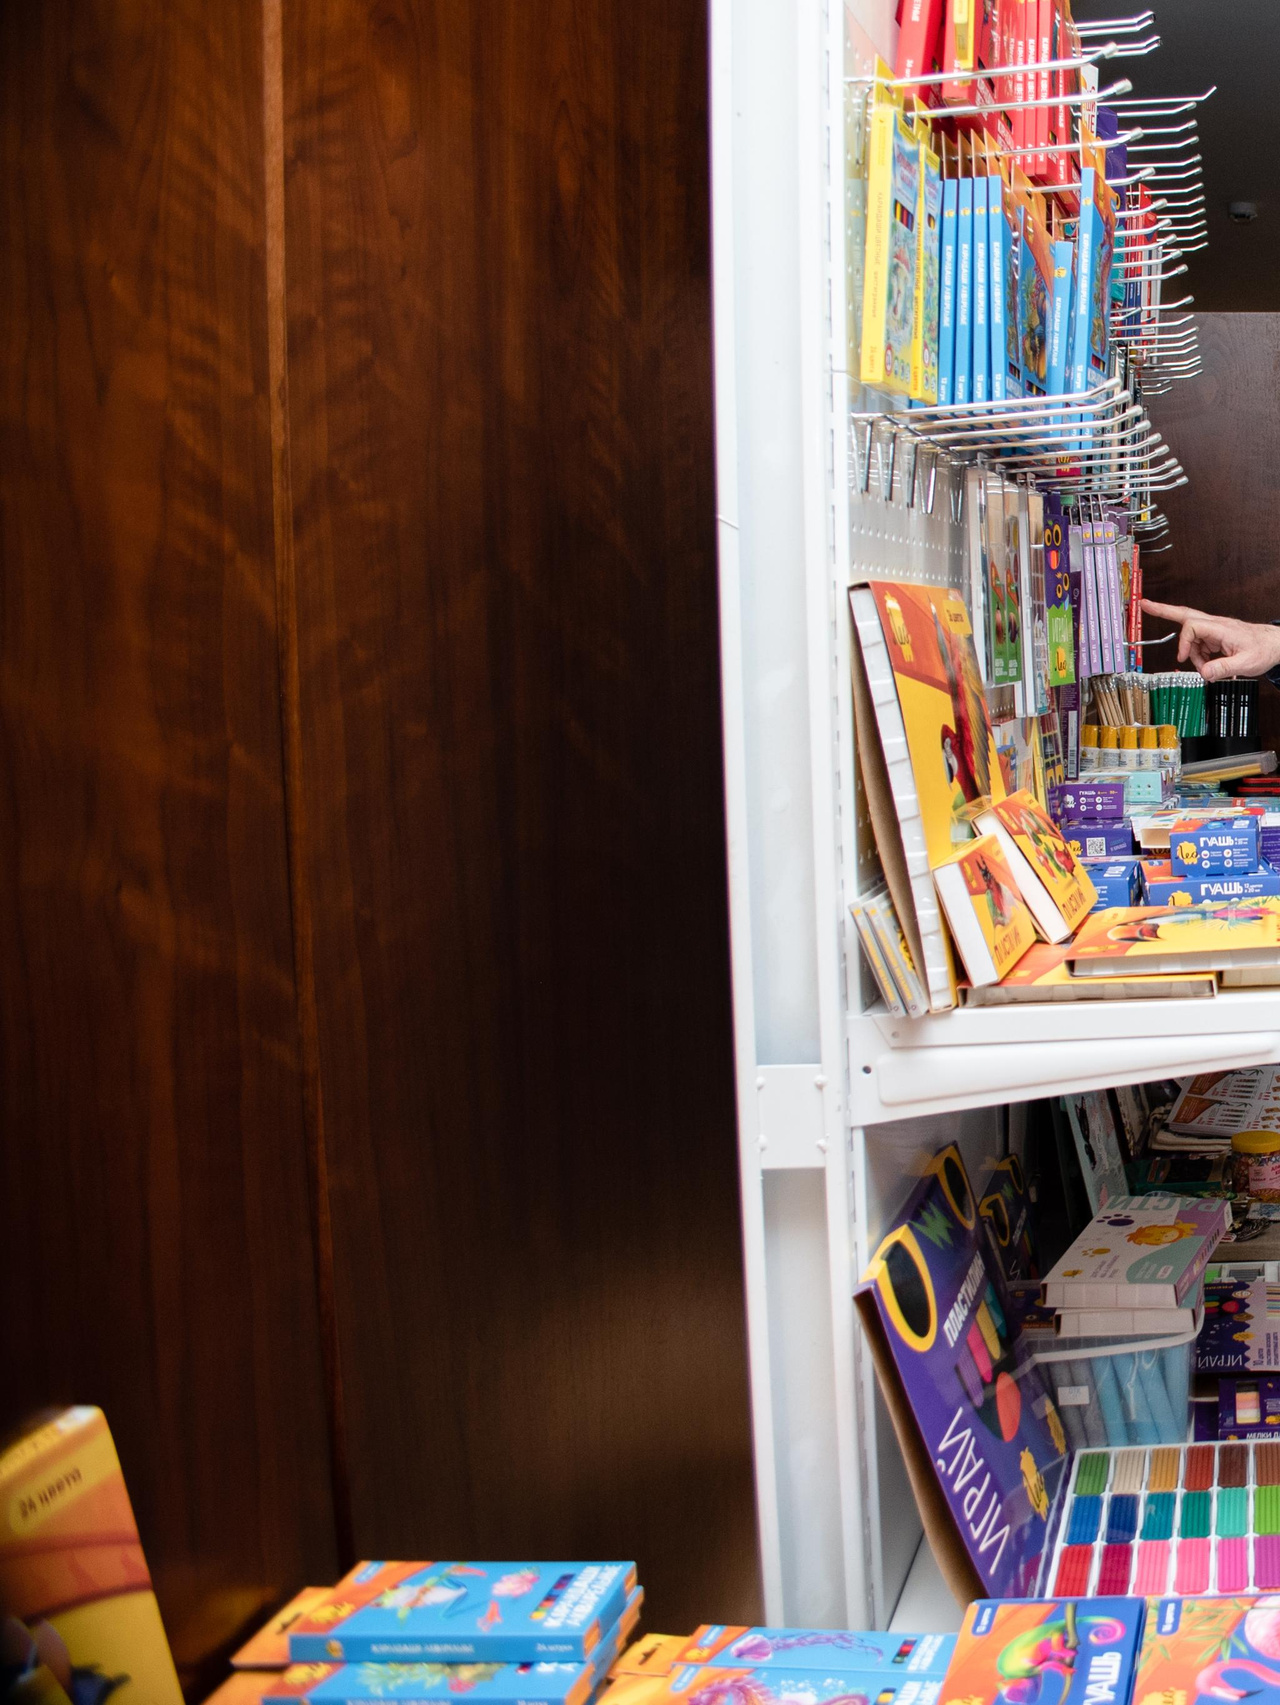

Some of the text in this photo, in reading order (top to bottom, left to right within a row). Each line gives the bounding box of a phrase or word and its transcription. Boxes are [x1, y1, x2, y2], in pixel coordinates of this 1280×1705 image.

[1200, 836, 1234, 847] ГУАШЬ
[1200, 882, 1243, 896] ГУАШЬ
[1107, 1194, 1224, 1213] РАСТИ
[943, 1250, 987, 1349] ПЛАСТИЛИН
[1246, 1431, 1273, 1440] МЕЛКИ
[935, 1406, 1012, 1576] ИГРАЙ
[1083, 1651, 1123, 1705] УАШЬ
